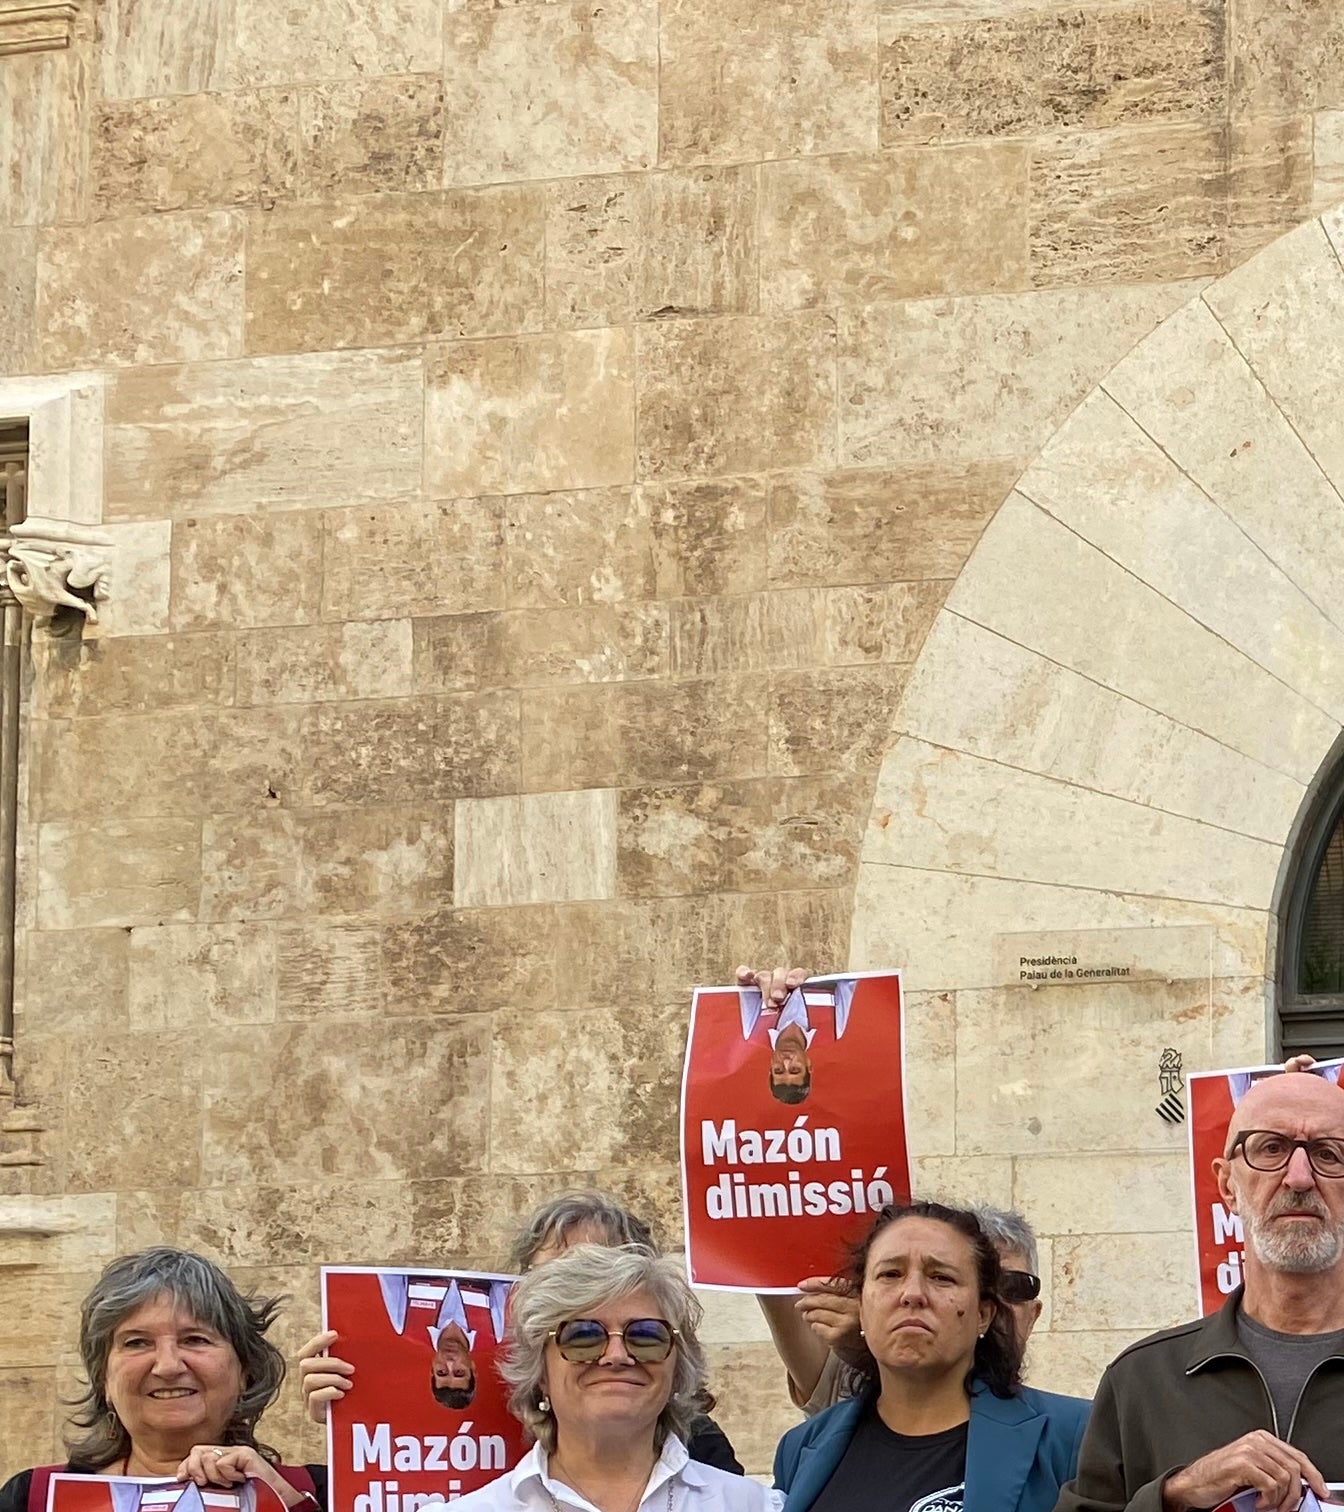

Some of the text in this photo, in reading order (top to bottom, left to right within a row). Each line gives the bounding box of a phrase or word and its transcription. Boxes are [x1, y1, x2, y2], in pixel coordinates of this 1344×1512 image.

[1020, 956, 1077, 966] Presidència
[1020, 966, 1130, 980] Palau de la Generalitat
[702, 1116, 841, 1165] Mazón
[707, 1167, 893, 1219] dimissió
[352, 1422, 505, 1471] Mazón
